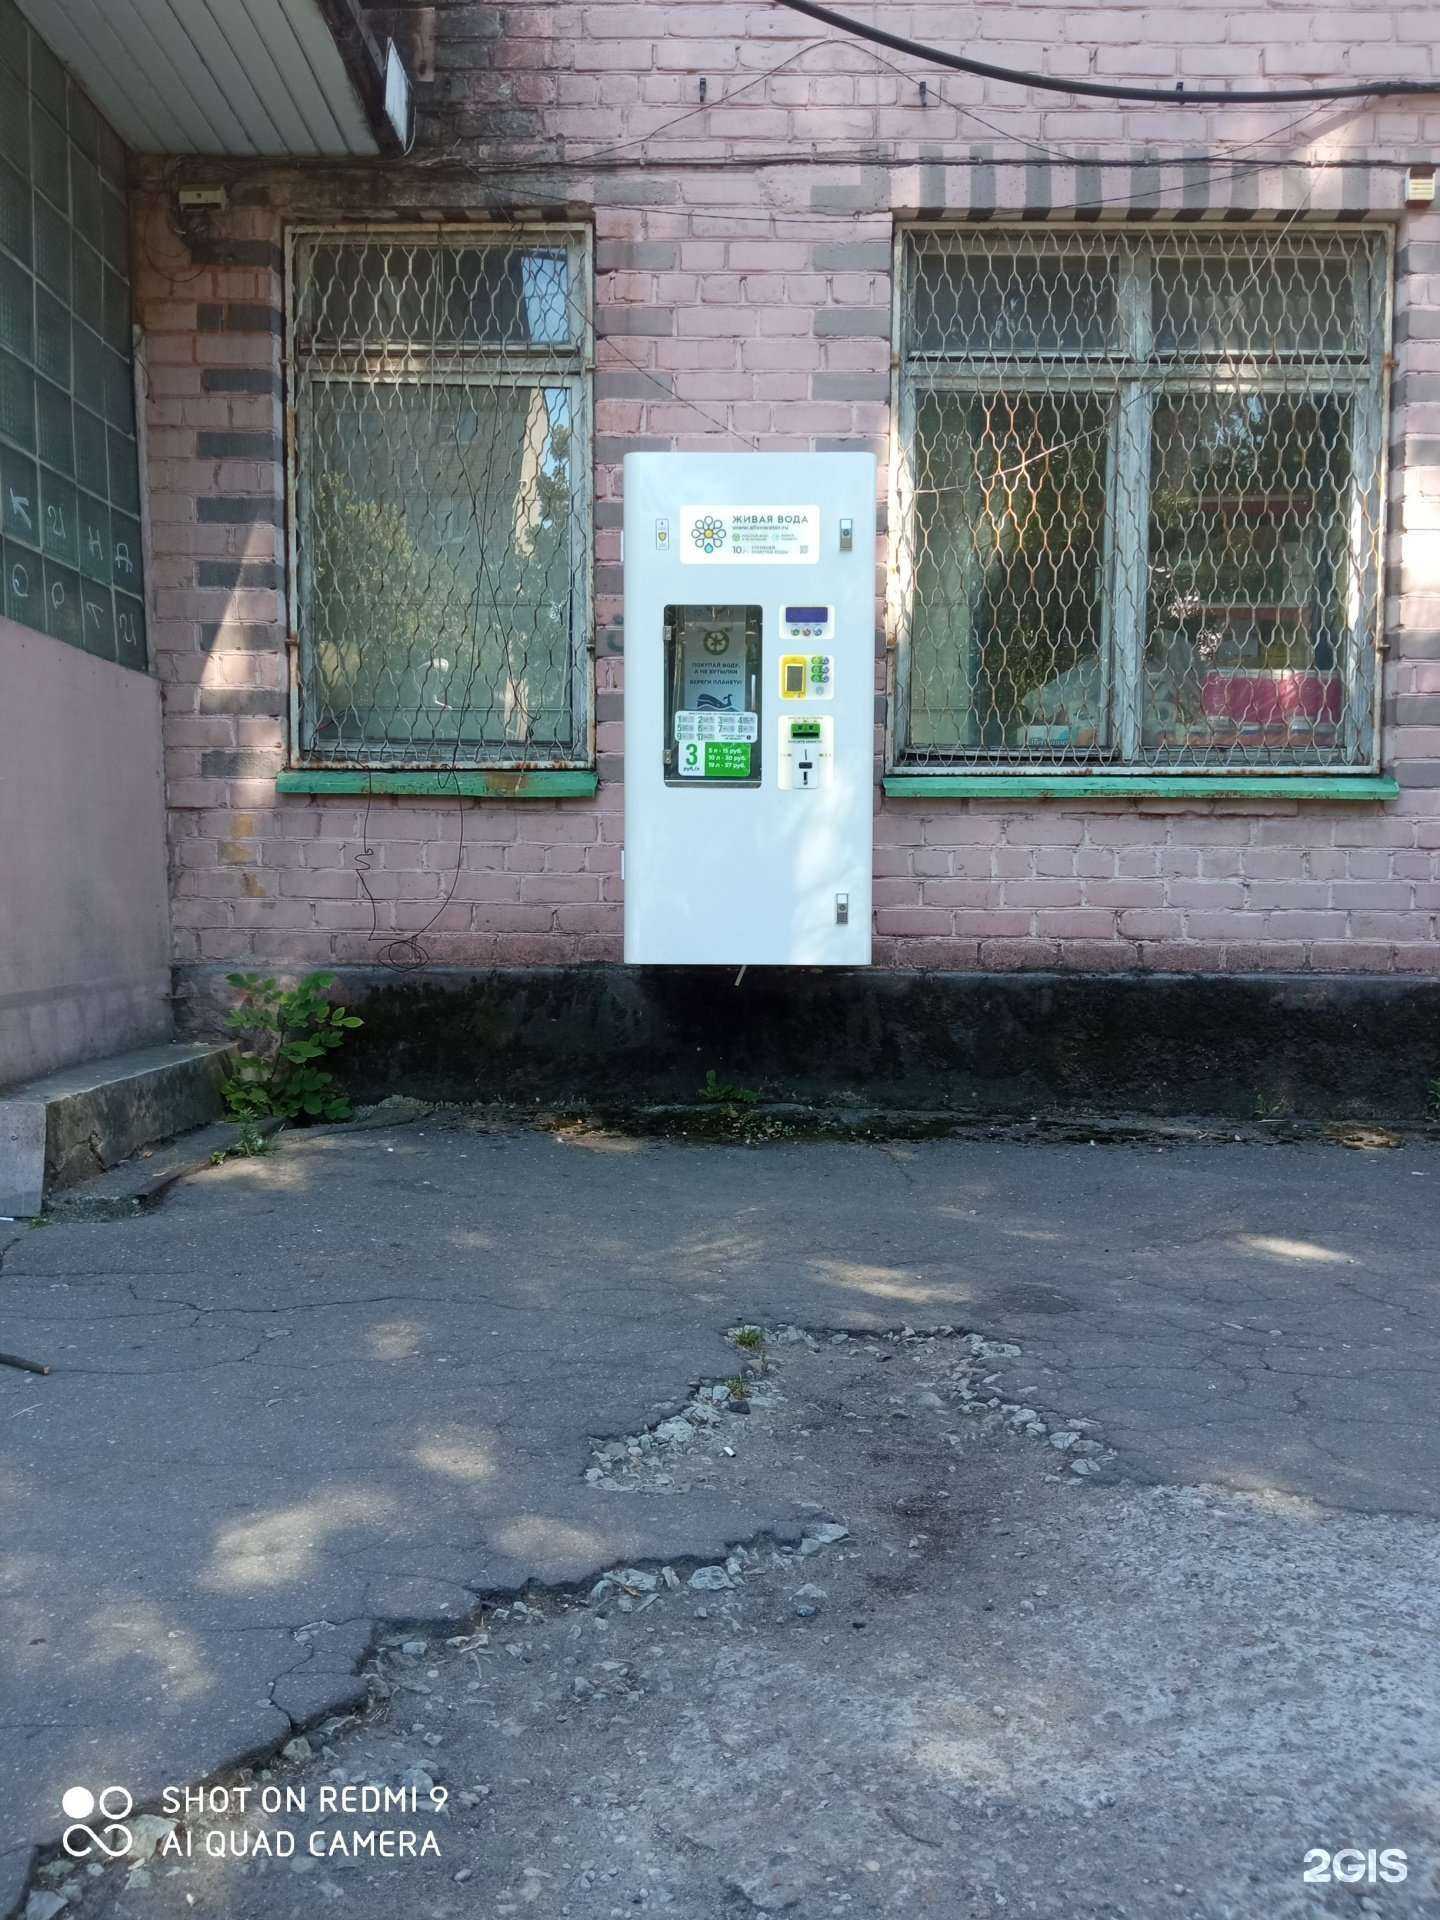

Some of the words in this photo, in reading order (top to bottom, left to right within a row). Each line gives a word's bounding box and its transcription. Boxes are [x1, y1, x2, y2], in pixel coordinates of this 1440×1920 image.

[732, 515, 773, 524] ЖИВАЯ
[777, 515, 809, 524] ВОДА
[686, 743, 698, 765] 3
